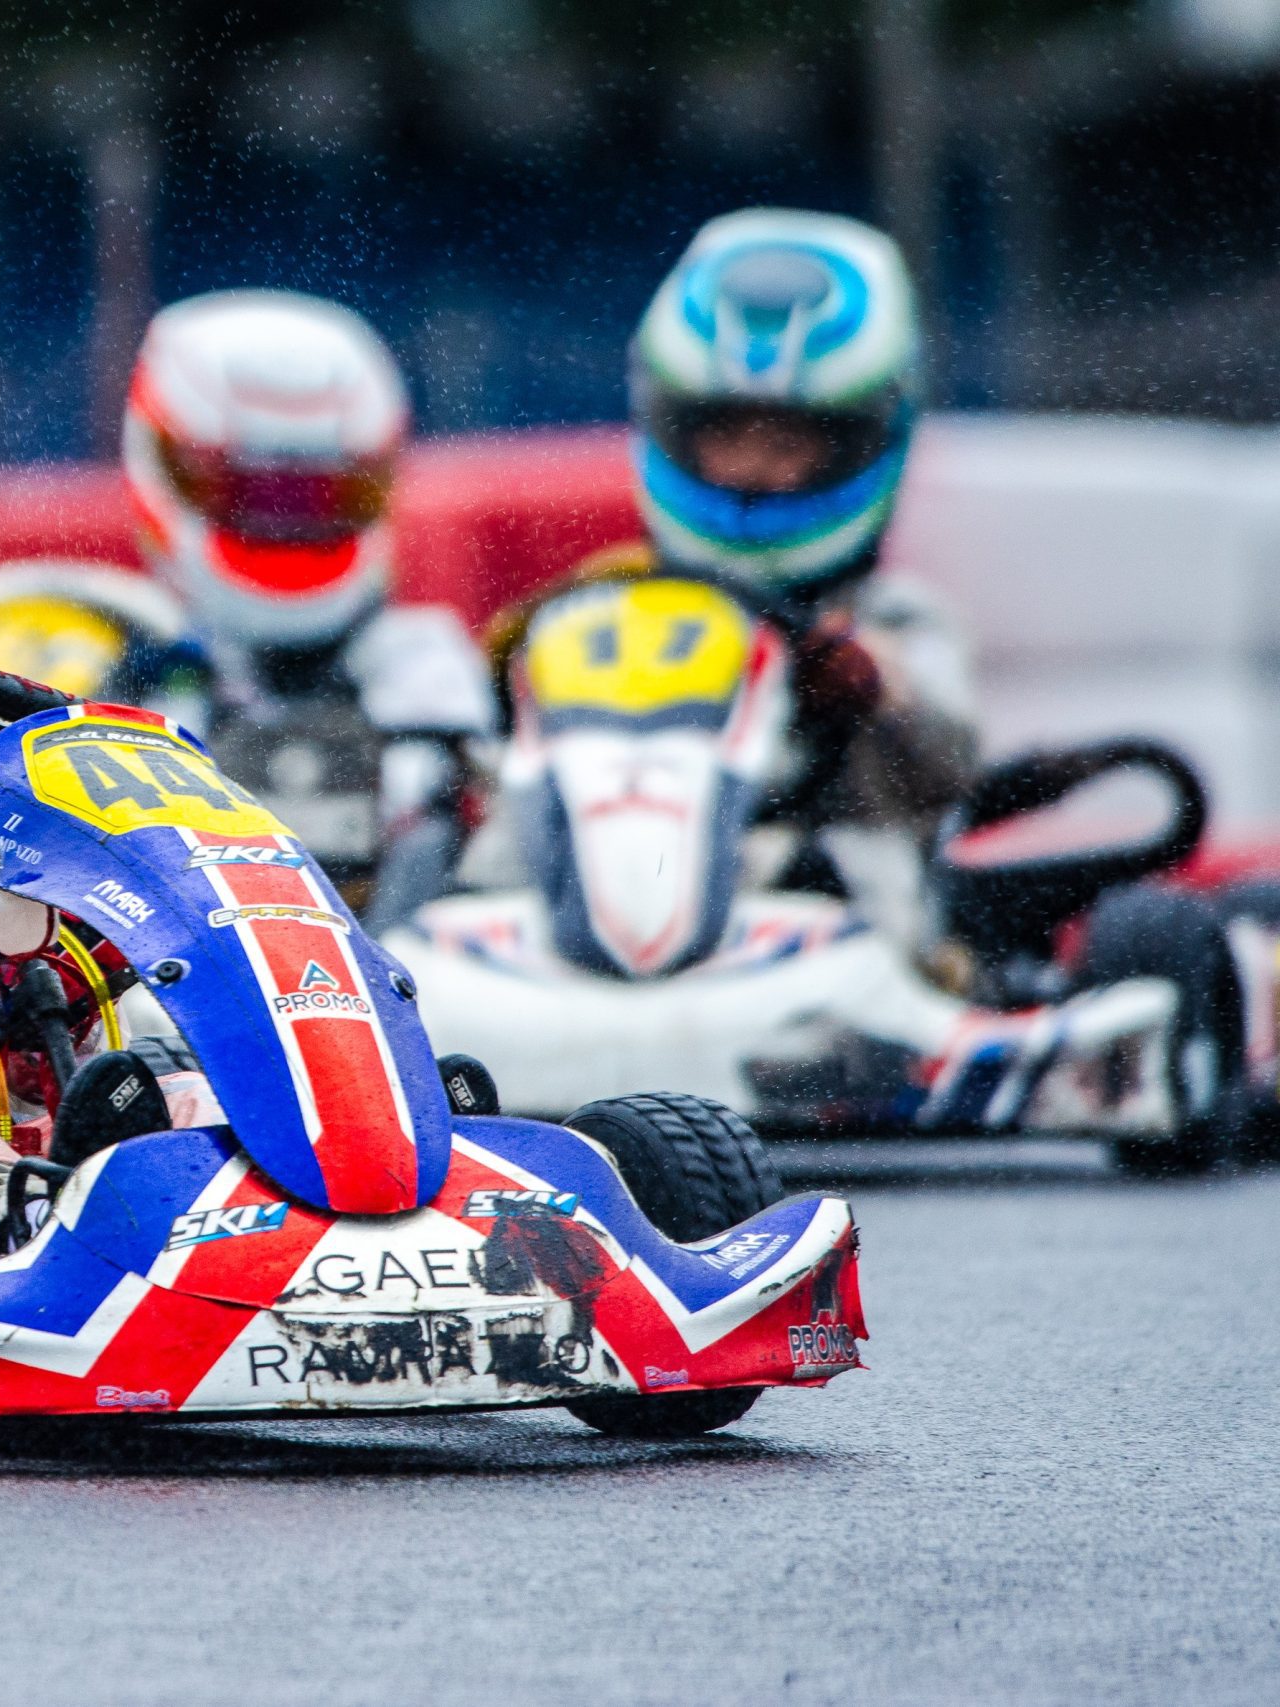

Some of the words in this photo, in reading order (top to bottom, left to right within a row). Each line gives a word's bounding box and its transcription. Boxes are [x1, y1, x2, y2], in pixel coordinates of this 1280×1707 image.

[107, 732, 176, 749] RAMPA
[92, 880, 156, 923] MARK
[273, 992, 371, 1014] PROMO
[111, 1077, 140, 1108] OMP
[450, 1076, 473, 1107] OMP
